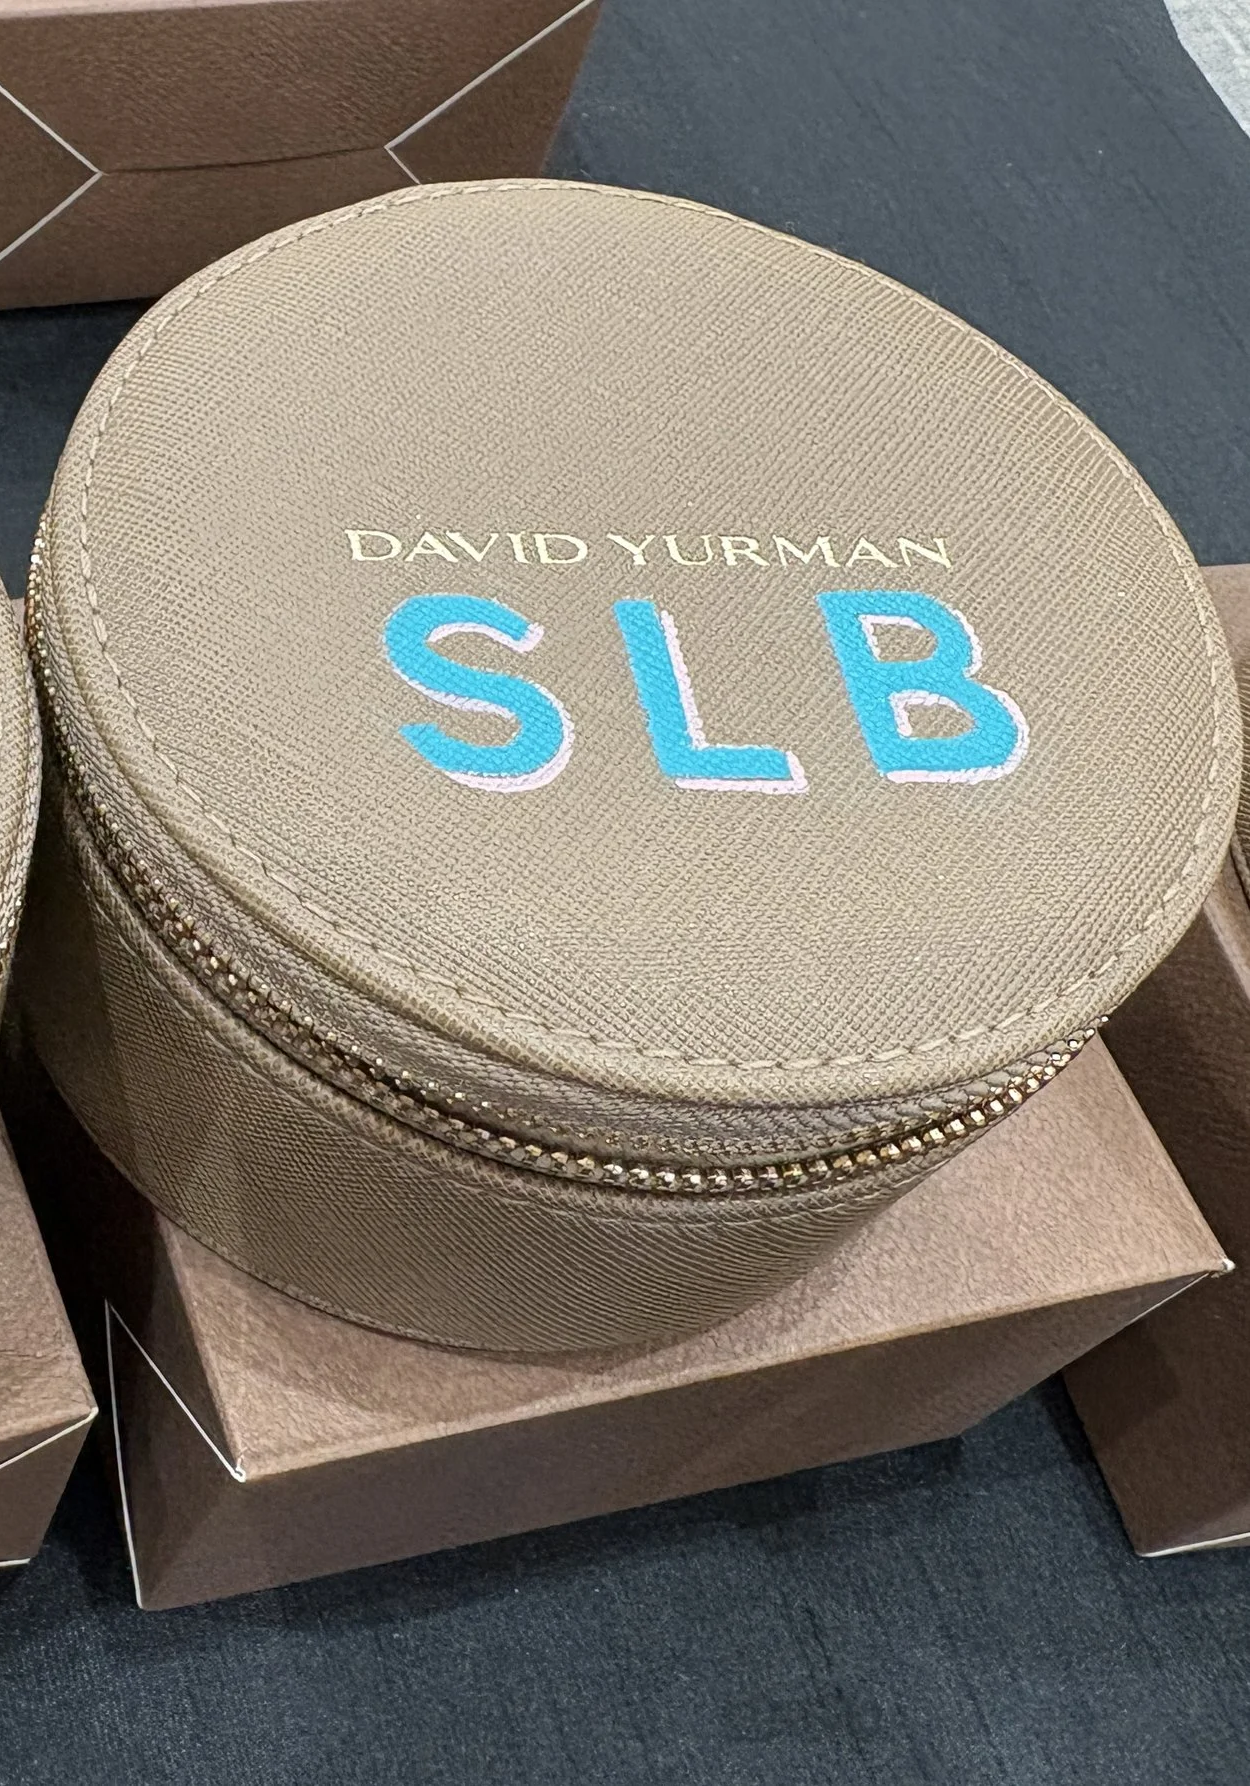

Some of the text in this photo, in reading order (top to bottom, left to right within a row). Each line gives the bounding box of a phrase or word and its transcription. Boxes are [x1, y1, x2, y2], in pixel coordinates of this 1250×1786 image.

[344, 528, 953, 569] DAVID YURMAN
[382, 590, 1030, 793] SLB
